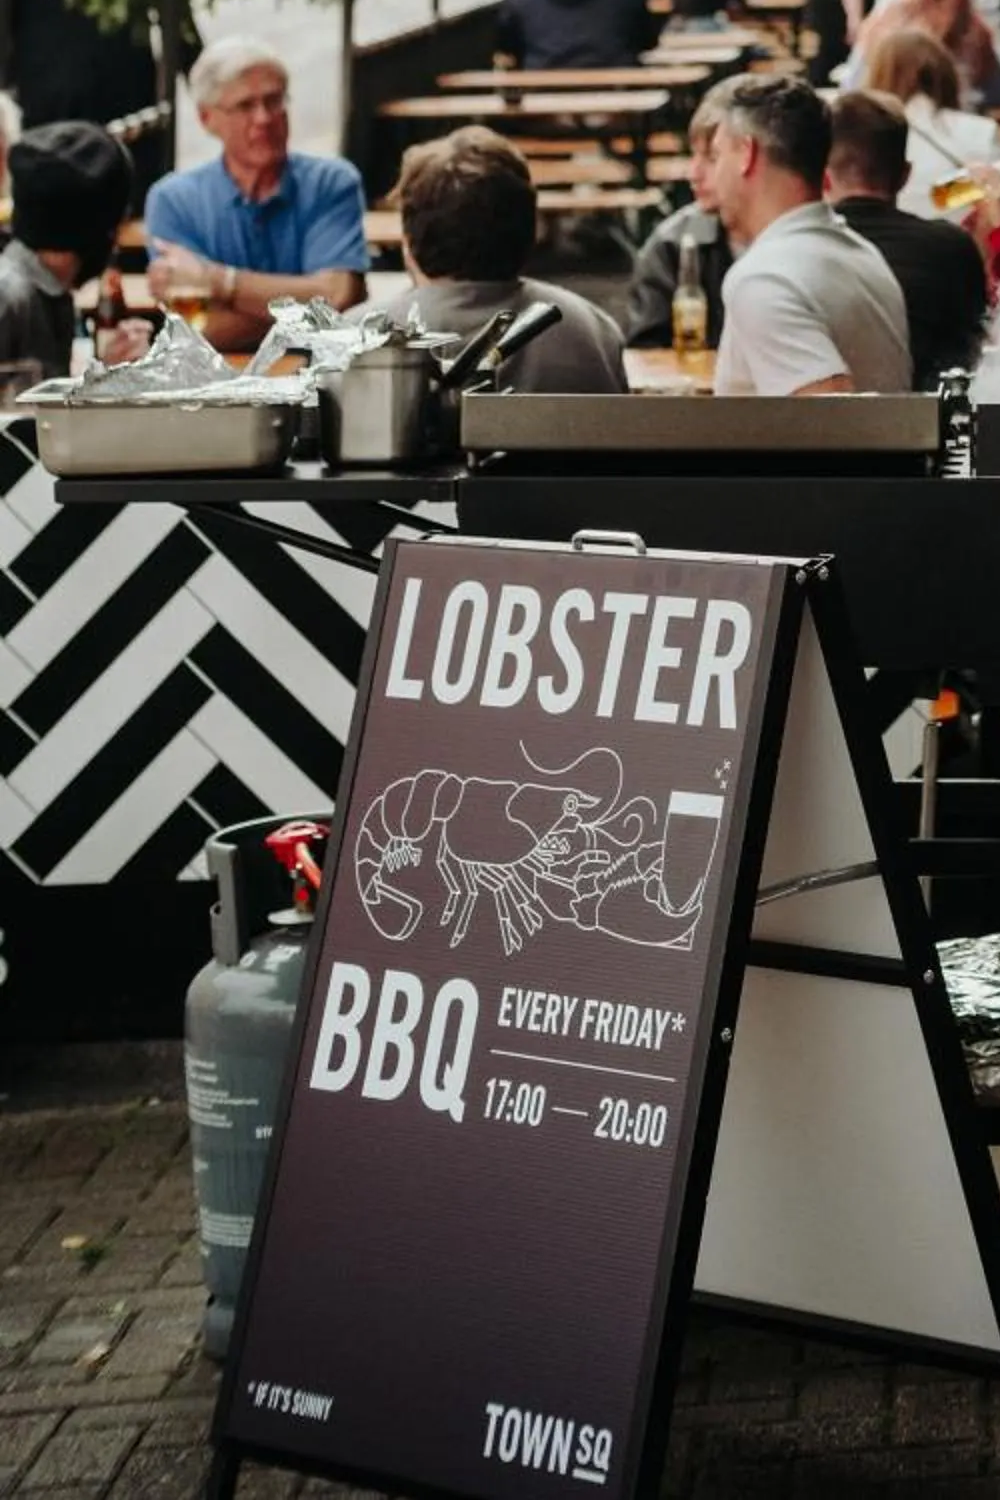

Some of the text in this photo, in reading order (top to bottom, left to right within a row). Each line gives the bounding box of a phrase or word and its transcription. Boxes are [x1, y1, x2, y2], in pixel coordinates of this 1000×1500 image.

[385, 577, 752, 730] LOBSTER
[309, 961, 479, 1124] BBQ
[497, 986, 579, 1036] EVERY
[484, 1077, 546, 1127] 17:00
[593, 1097, 668, 1148] 20:00
[483, 1402, 613, 1484] TOWN SQ
